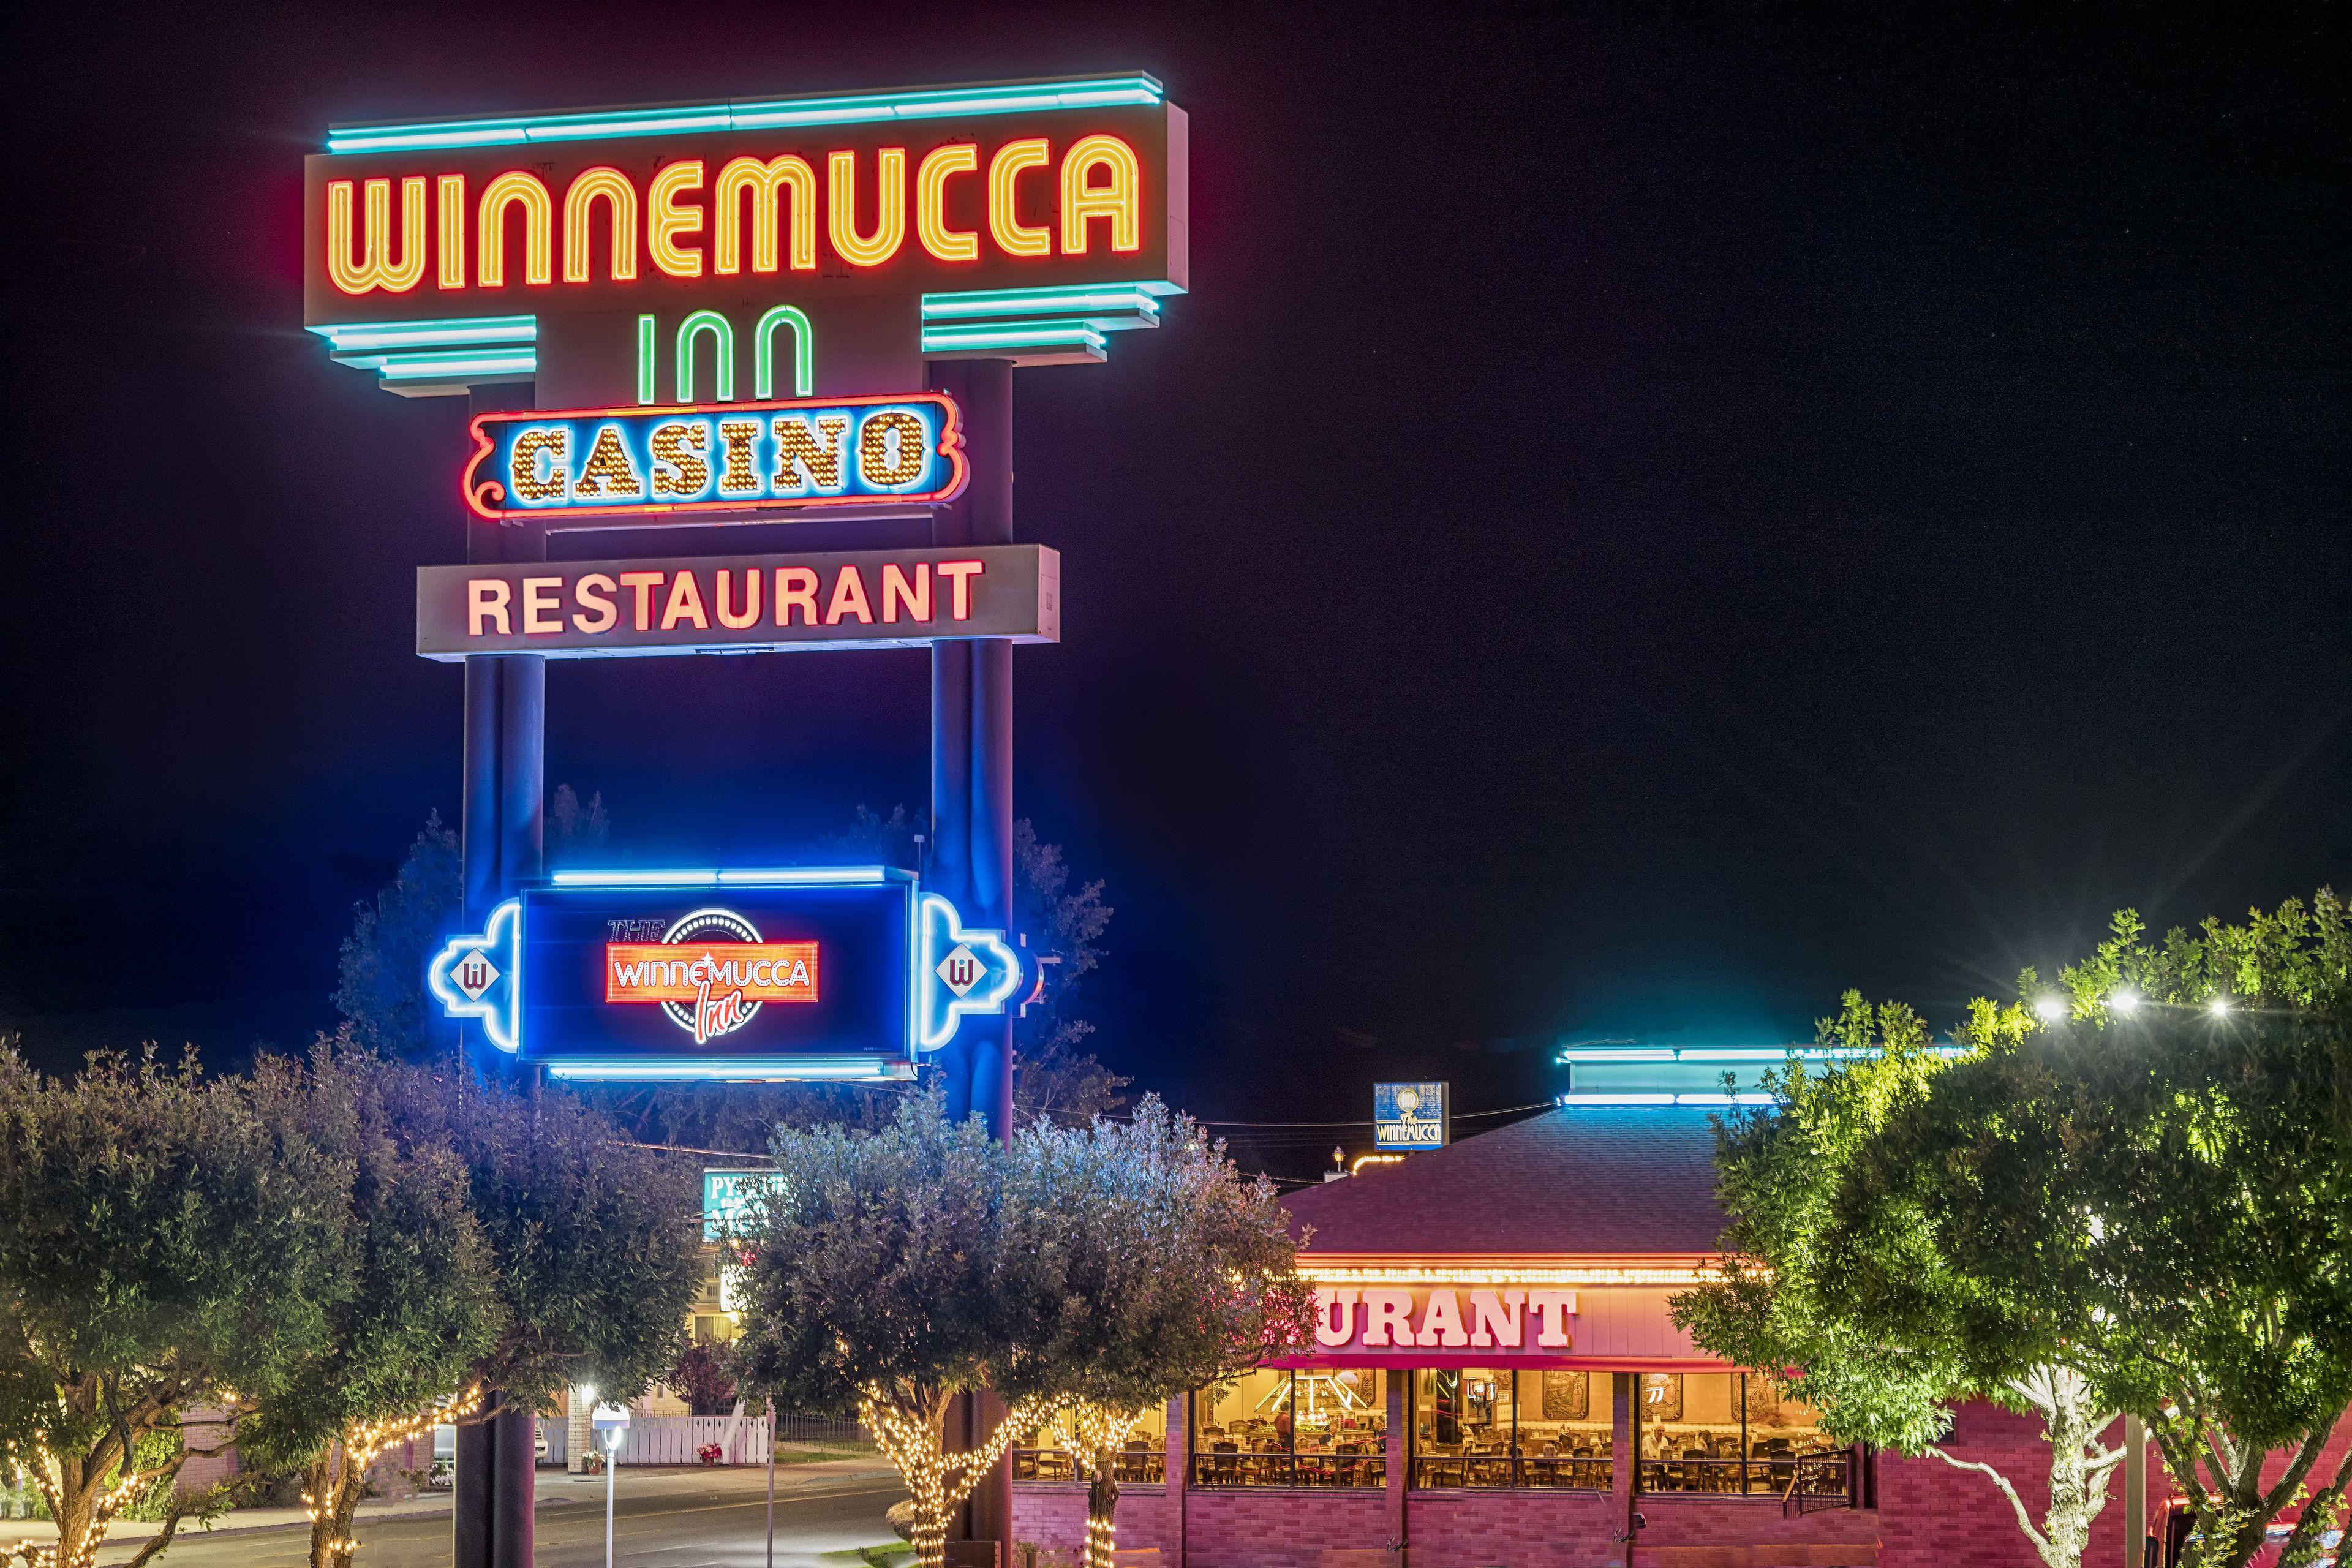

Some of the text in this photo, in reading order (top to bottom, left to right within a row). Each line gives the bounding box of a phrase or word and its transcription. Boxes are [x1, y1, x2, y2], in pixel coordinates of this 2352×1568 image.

[328, 134, 1139, 295] WINNEMUCCA
[638, 305, 813, 405] INN
[510, 409, 931, 505] CASINO
[467, 560, 986, 636] RESTAURANT
[607, 919, 666, 942] THE
[614, 959, 810, 987] WINNEMUCCA
[695, 979, 743, 1042] Inn
[1376, 1123, 1441, 1141] WINNEMUCCA
[1267, 1290, 1578, 1348] URANT
